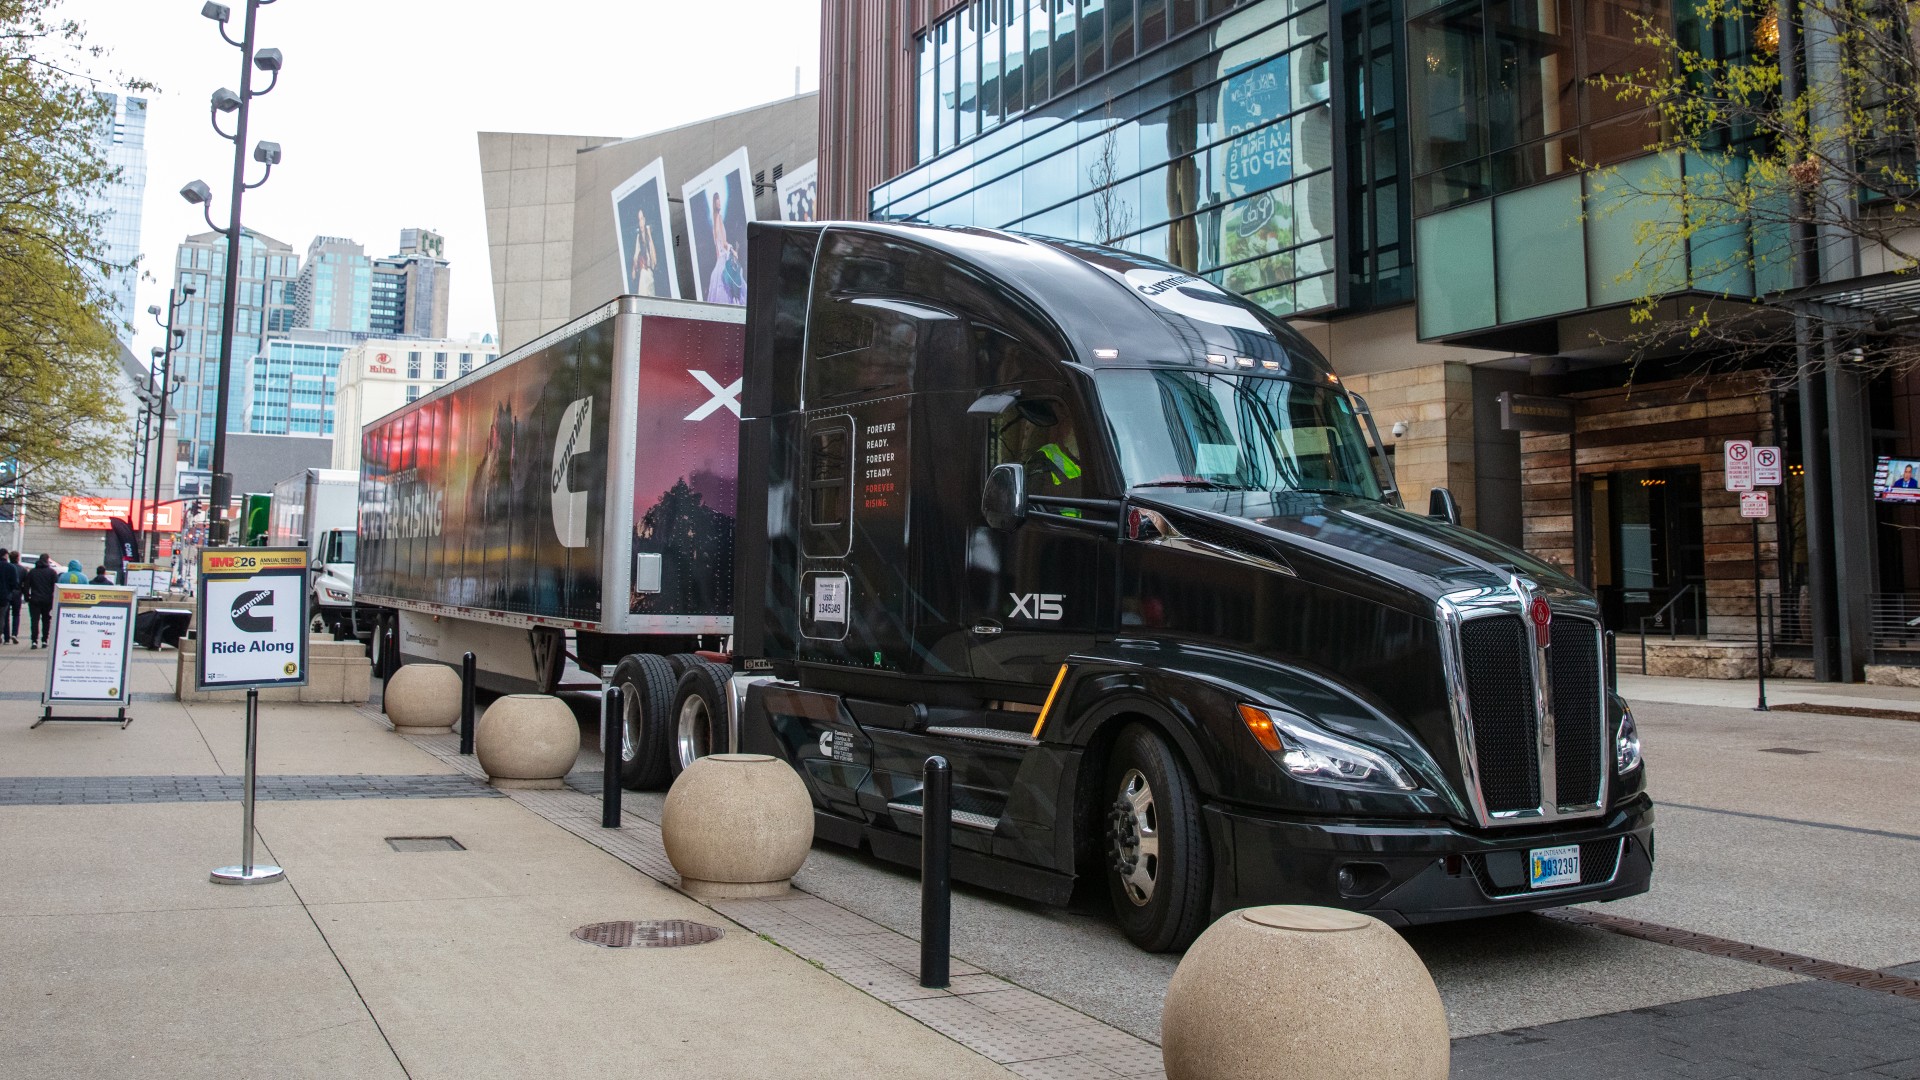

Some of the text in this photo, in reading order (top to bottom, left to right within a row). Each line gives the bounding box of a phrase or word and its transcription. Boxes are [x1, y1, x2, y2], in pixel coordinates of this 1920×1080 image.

[1137, 274, 1199, 296] Cummins
[368, 364, 396, 375] Hilton
[866, 422, 896, 435] FOREVER
[552, 397, 590, 494] Cummins
[866, 438, 889, 450] READY.
[866, 452, 895, 464] FOREVER
[865, 468, 892, 479] STEADY.
[865, 483, 895, 493] FOREVER
[865, 499, 889, 508] RISING.
[402, 490, 443, 538] RISING
[231, 589, 271, 618] Cummins
[1008, 592, 1064, 621] X15
[211, 640, 295, 654] Ride Along
[1543, 848, 1566, 857] INDIANA
